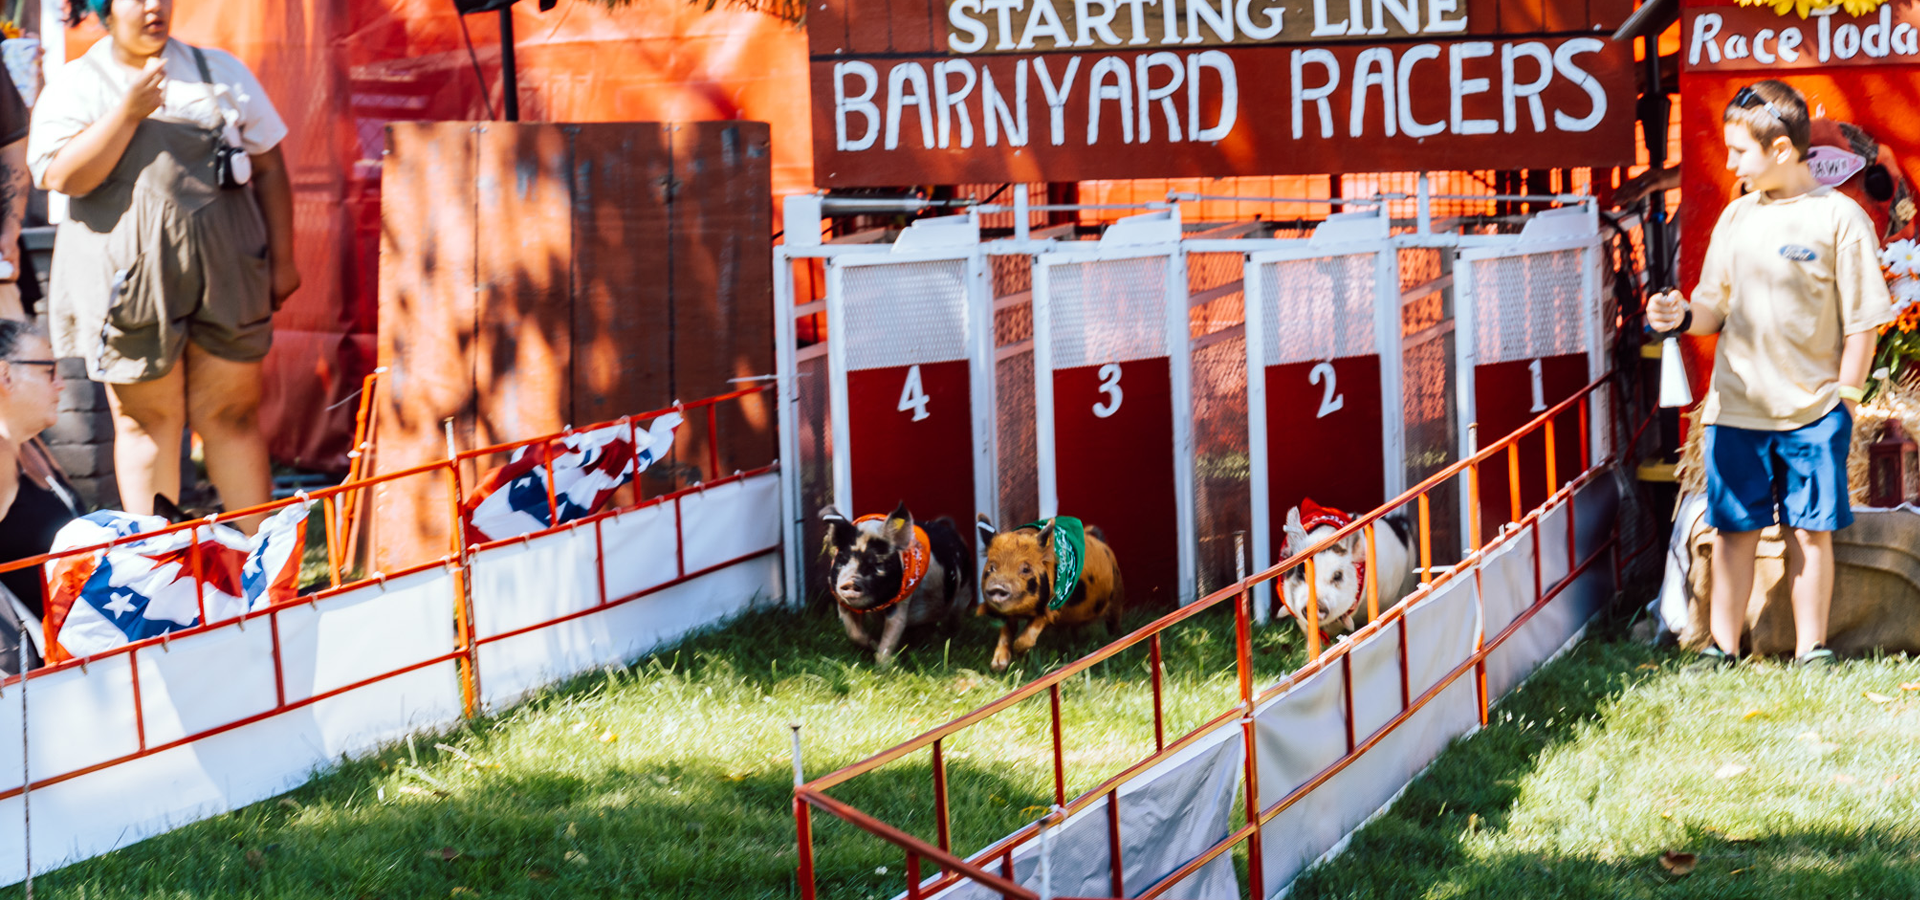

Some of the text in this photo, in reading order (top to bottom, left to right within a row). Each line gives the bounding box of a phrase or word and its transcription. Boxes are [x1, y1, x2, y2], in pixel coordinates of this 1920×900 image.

[948, 0, 1467, 53] STARTING LINE
[1688, 13, 1803, 65] Race
[834, 38, 1607, 151] BARNYARD RACERS
[897, 364, 930, 422] 4
[1093, 363, 1123, 418] 3
[1309, 362, 1343, 419] 2
[1528, 358, 1547, 412] 1
